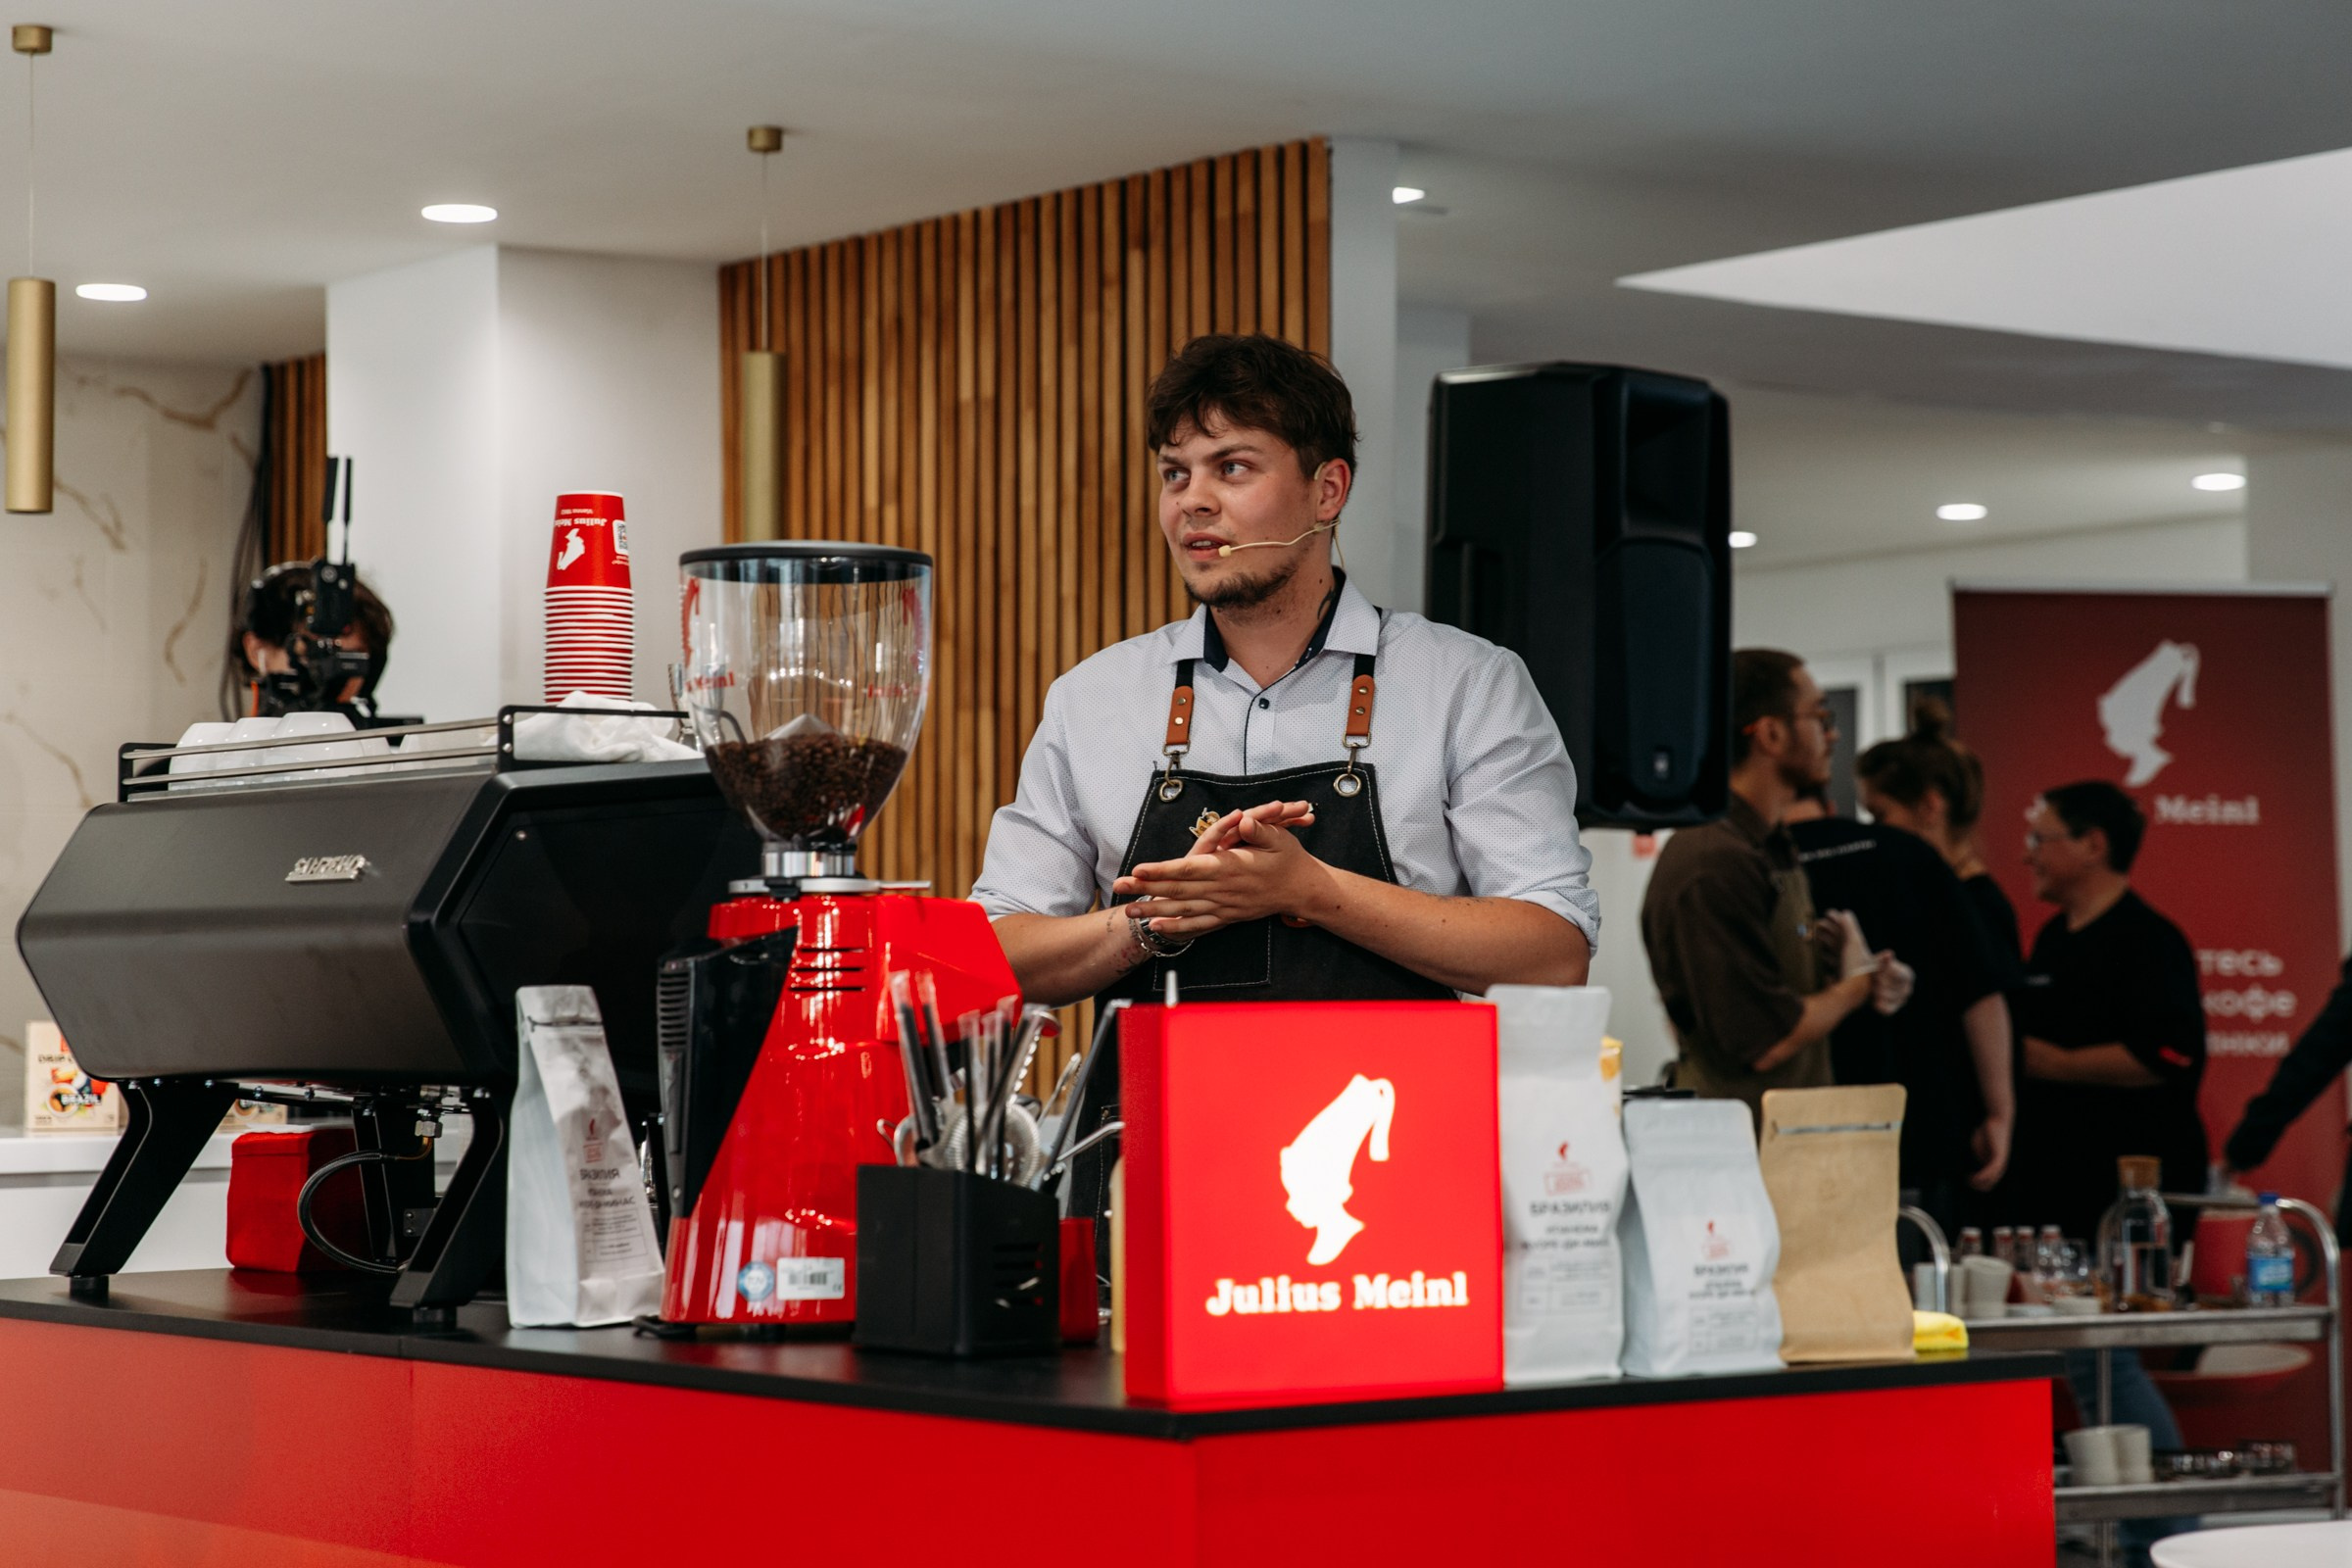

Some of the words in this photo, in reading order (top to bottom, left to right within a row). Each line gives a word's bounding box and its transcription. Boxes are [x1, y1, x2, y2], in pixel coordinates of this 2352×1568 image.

[573, 516, 608, 527] Julius
[2155, 795, 2260, 825] Meinl
[1204, 1275, 1343, 1317] Julius
[1352, 1269, 1470, 1310] Meinl
